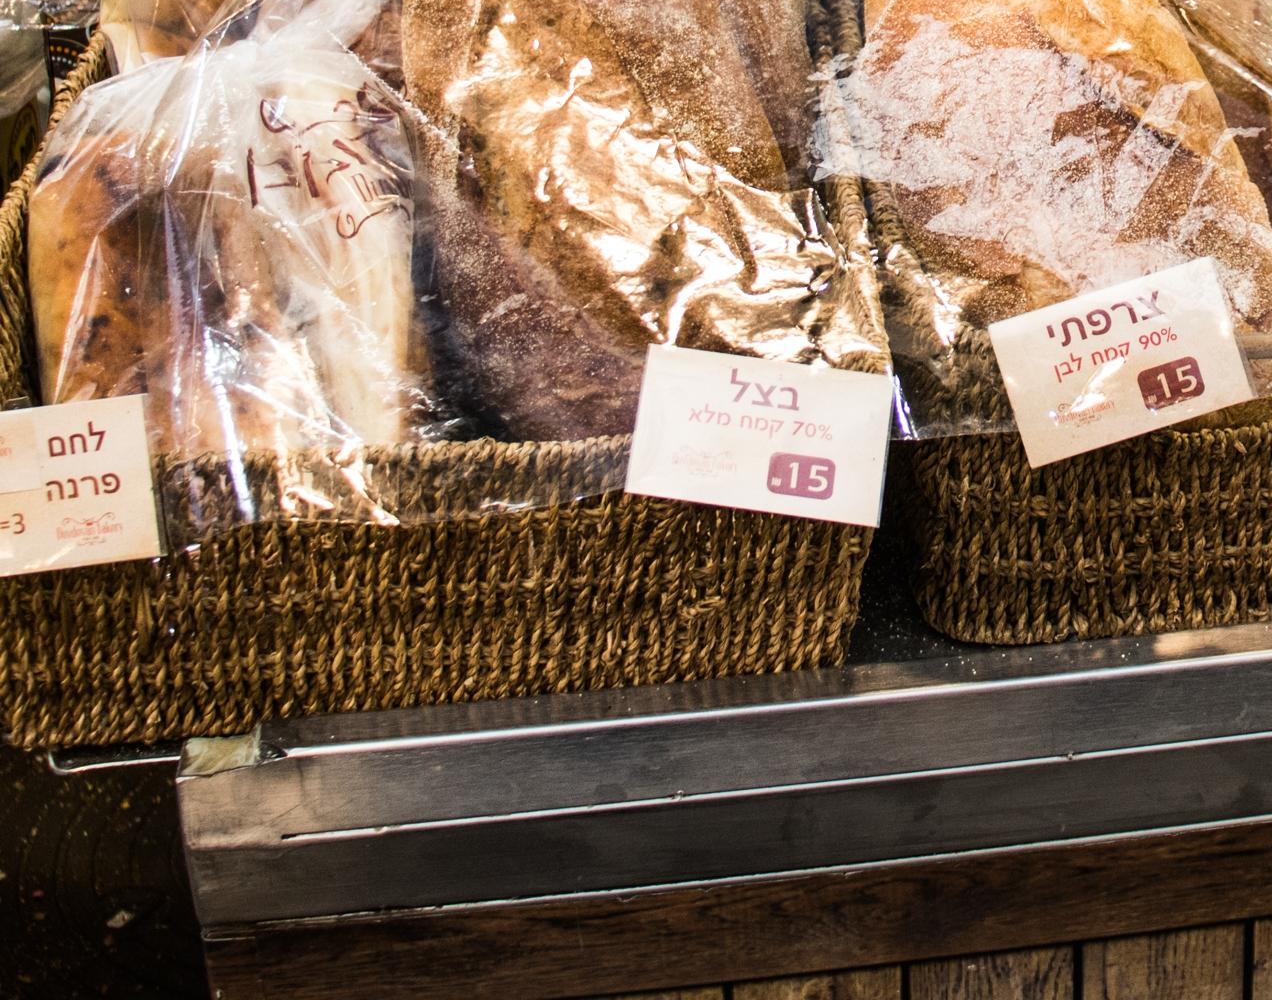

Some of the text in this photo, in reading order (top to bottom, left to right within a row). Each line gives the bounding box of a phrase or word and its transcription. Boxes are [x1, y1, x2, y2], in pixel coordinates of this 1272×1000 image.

[1046, 290, 1167, 347] צרפתי
[1054, 326, 1178, 383] 90% קמח לבן
[730, 367, 800, 411] בצל
[1157, 363, 1198, 399] 15
[47, 420, 106, 458] לחם
[688, 406, 833, 441] 70% קמח מלא
[45, 472, 121, 502] פרנה
[788, 461, 830, 493] 15
